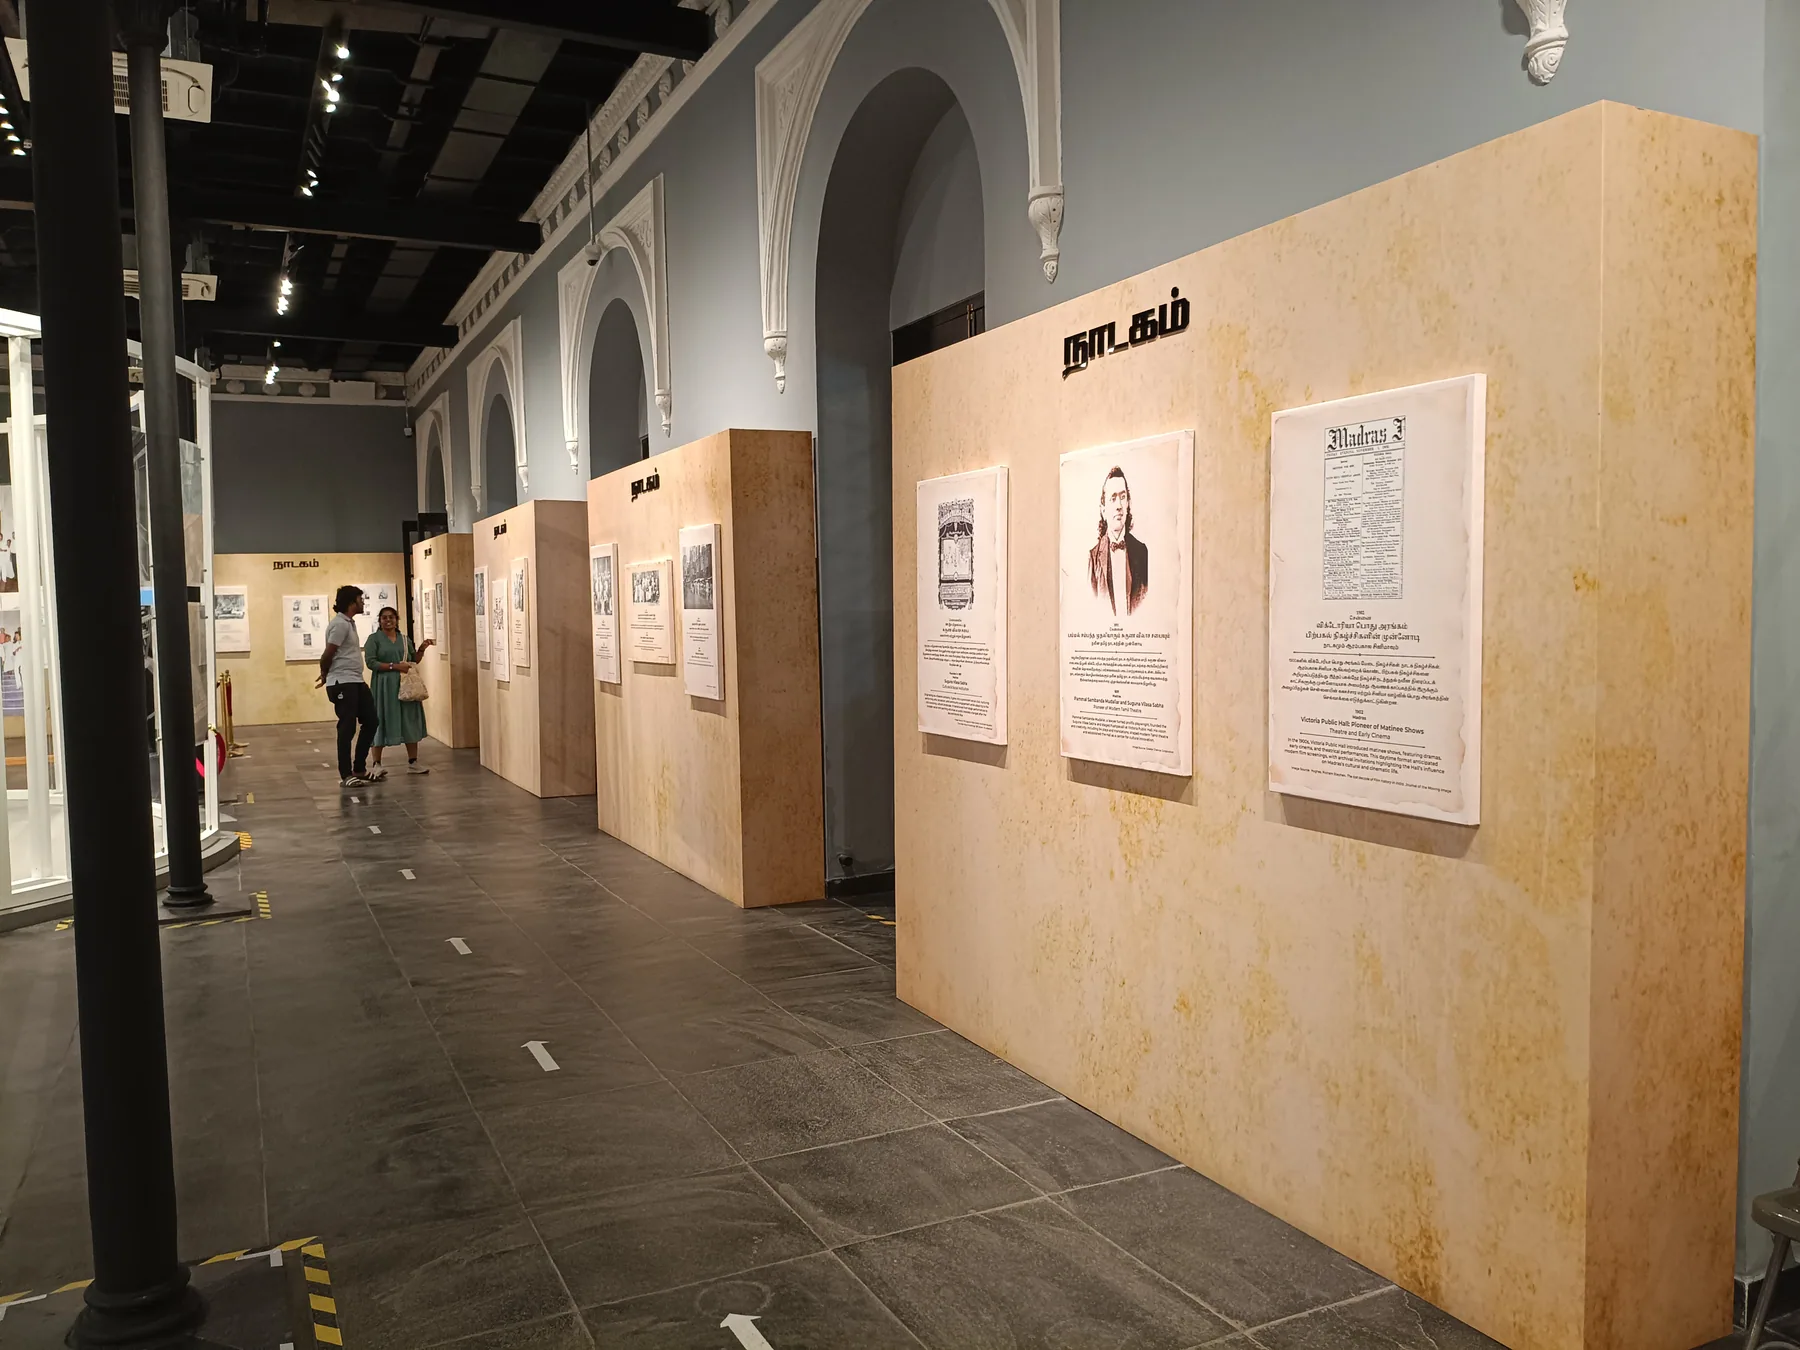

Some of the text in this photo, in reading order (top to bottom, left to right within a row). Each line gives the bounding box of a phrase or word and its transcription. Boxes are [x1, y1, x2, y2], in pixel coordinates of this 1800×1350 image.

[1062, 286, 1190, 381] நாடகம்
[1327, 425, 1387, 452] Madras
[272, 558, 319, 570] நாடகம்
[1316, 622, 1408, 631] விக்டோரியா பொது அரங்கம்
[1306, 631, 1420, 643] பிற்பகல் நிகழ்ச்சிகளின் முன்னோடி
[1301, 716, 1320, 724] Victoria
[1321, 718, 1337, 726] Public
[1351, 721, 1372, 729] Pioneer
[1380, 724, 1403, 732] Matinee
[1405, 727, 1425, 735] Shows
[1371, 732, 1391, 740] Cinema
[1376, 761, 1402, 769] highlighting
